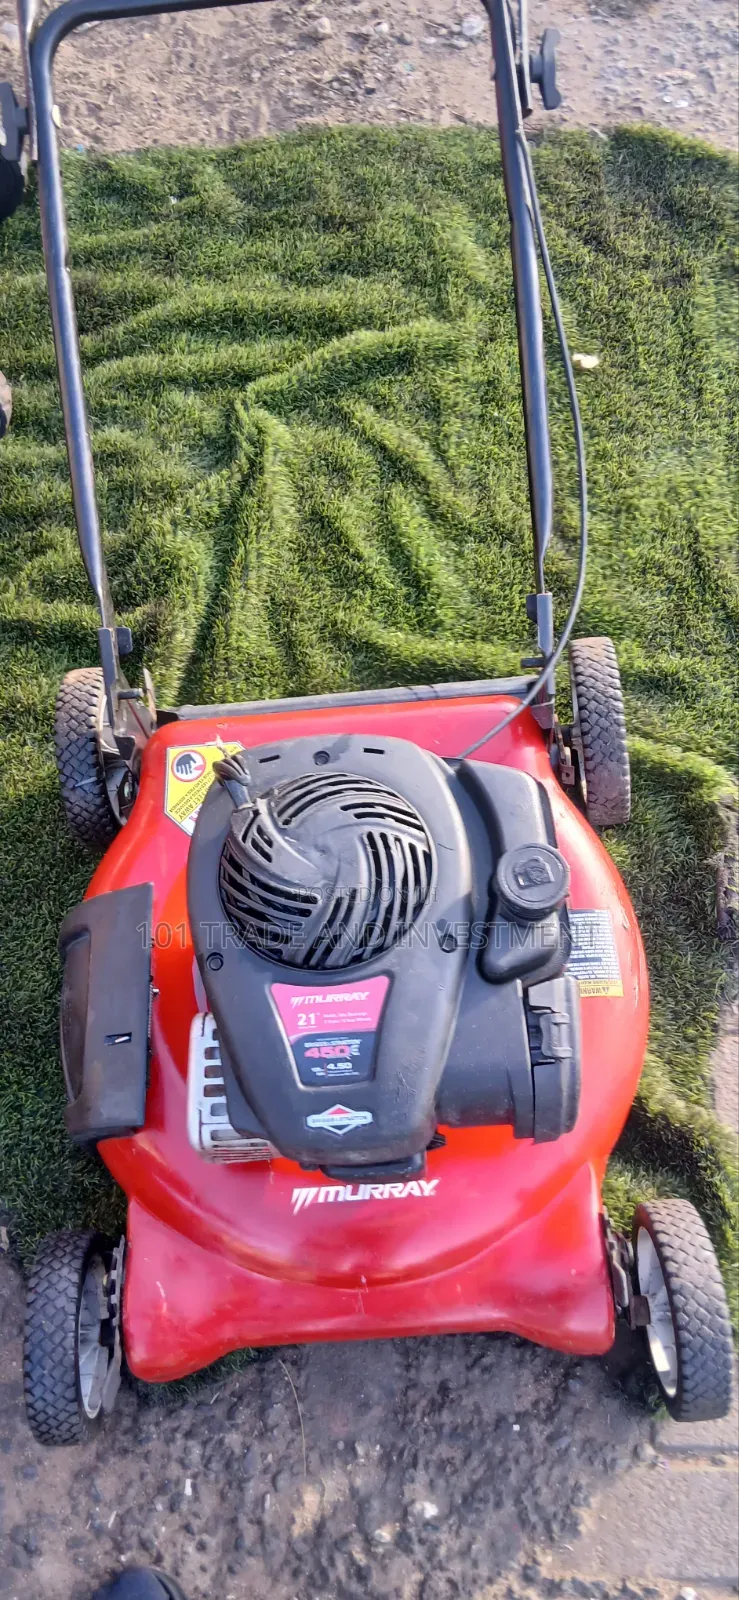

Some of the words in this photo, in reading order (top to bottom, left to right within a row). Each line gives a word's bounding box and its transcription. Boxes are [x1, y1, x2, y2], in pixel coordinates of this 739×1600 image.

[177, 803, 194, 820] AWAY
[304, 991, 370, 1005] MURRAY
[317, 1179, 440, 1204] MURRAY
